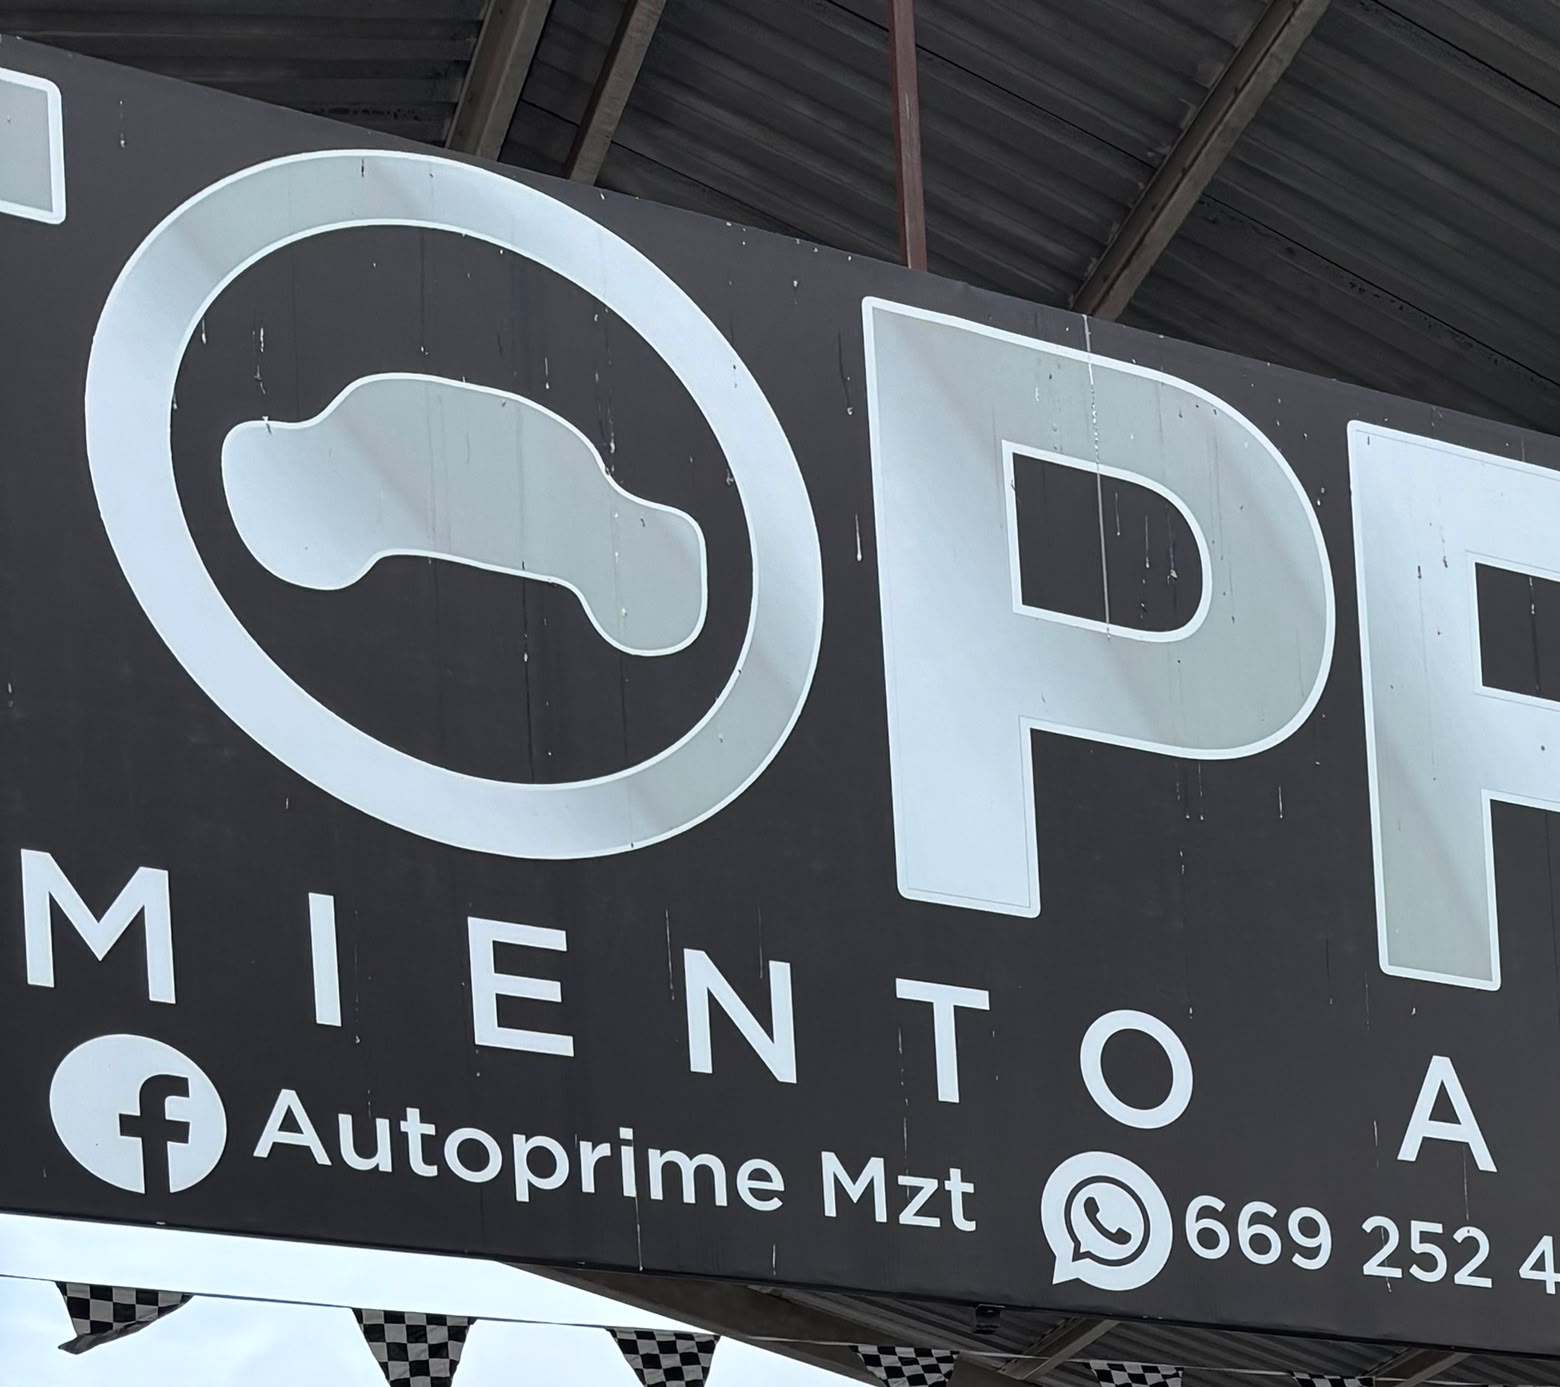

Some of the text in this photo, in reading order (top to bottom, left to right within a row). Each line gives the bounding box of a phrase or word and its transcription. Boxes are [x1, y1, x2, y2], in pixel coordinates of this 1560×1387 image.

[18, 847, 1193, 1129] MIENTO
[252, 1087, 786, 1212] Autoprime
[820, 1150, 977, 1232] Mzt
[1184, 1194, 1333, 1271] 669
[1360, 1215, 1494, 1289] 252
